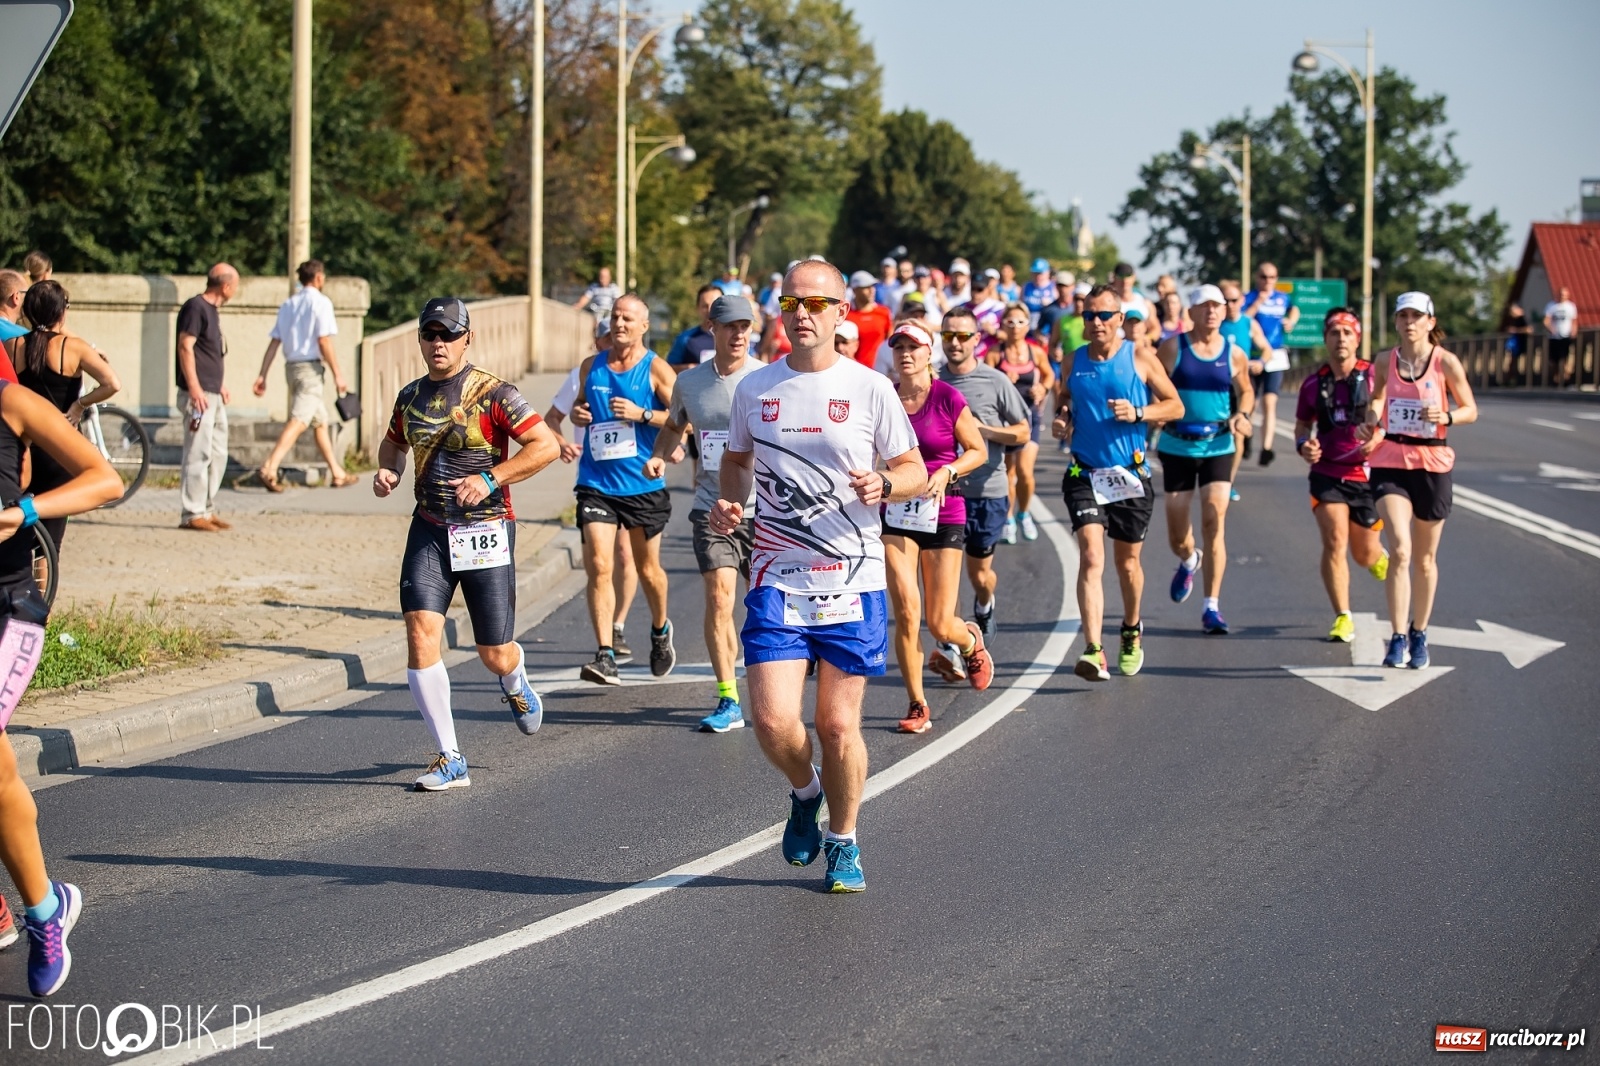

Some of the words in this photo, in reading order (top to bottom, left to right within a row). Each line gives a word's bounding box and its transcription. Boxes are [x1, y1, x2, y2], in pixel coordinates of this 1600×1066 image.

[604, 431, 619, 444] 87
[904, 501, 919, 513] 31
[470, 533, 497, 550] 185
